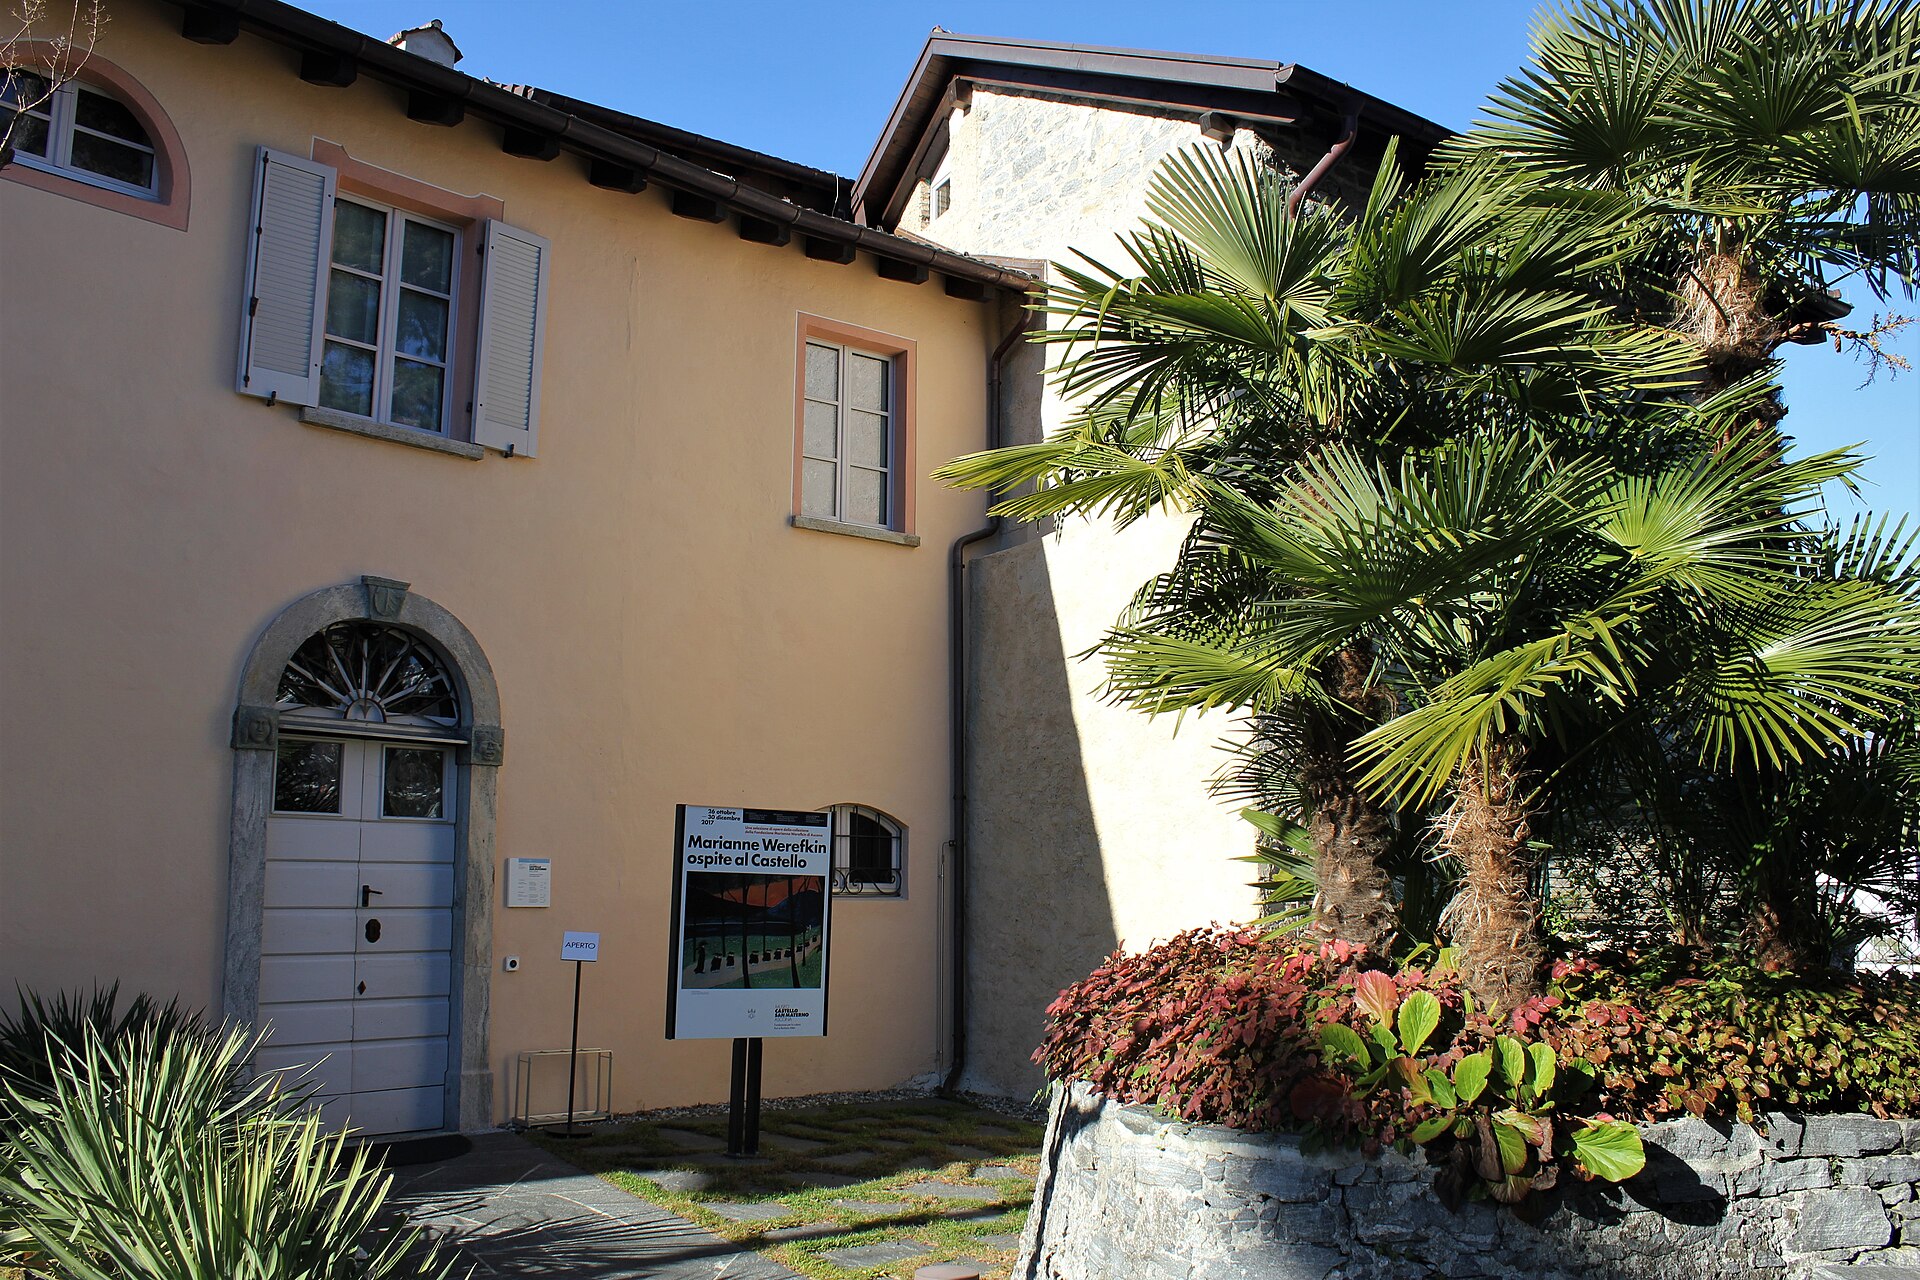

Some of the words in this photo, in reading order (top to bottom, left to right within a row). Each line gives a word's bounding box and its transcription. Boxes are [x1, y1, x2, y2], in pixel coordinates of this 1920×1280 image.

[687, 835, 760, 851] Marianne
[762, 838, 827, 854] Werefkin
[687, 851, 732, 868] ospite
[735, 852, 748, 867] al
[751, 854, 807, 868] Castello
[565, 942, 596, 950] APERTO
